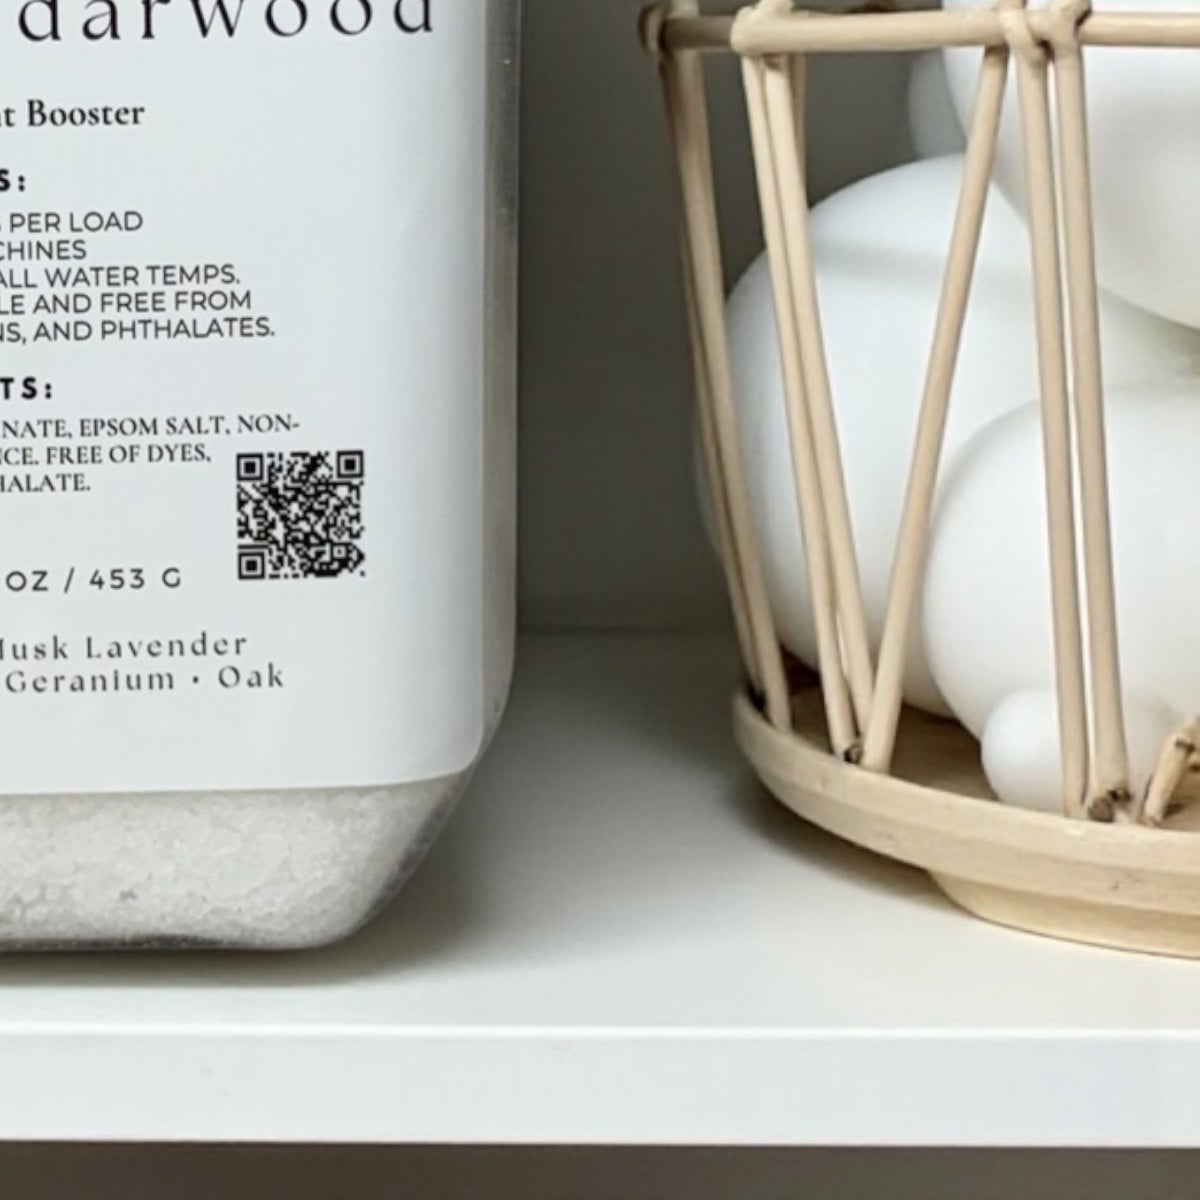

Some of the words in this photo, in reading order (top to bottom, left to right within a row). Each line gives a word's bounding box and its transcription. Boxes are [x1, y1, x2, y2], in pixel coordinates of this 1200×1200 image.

[26, 98, 146, 128] Booster
[9, 211, 62, 234] PER
[69, 210, 144, 233] LOAD
[43, 265, 140, 289] WATER
[145, 262, 241, 287] TEMPS.
[32, 292, 93, 315] AND
[100, 290, 167, 314] FREE
[174, 289, 252, 312] FROM
[32, 319, 94, 342] AND
[100, 315, 276, 341] PHTHALATES.
[79, 417, 159, 438] EPSOM
[237, 413, 300, 434] NON-
[46, 445, 103, 466] FREE
[108, 444, 141, 464] OF
[147, 442, 212, 463] DYES,
[4, 569, 49, 593] OZ
[88, 567, 146, 591] 453
[161, 566, 182, 589] G
[85, 630, 248, 660] Lavender
[5, 669, 174, 694] Geranium
[217, 661, 284, 689] Oak
